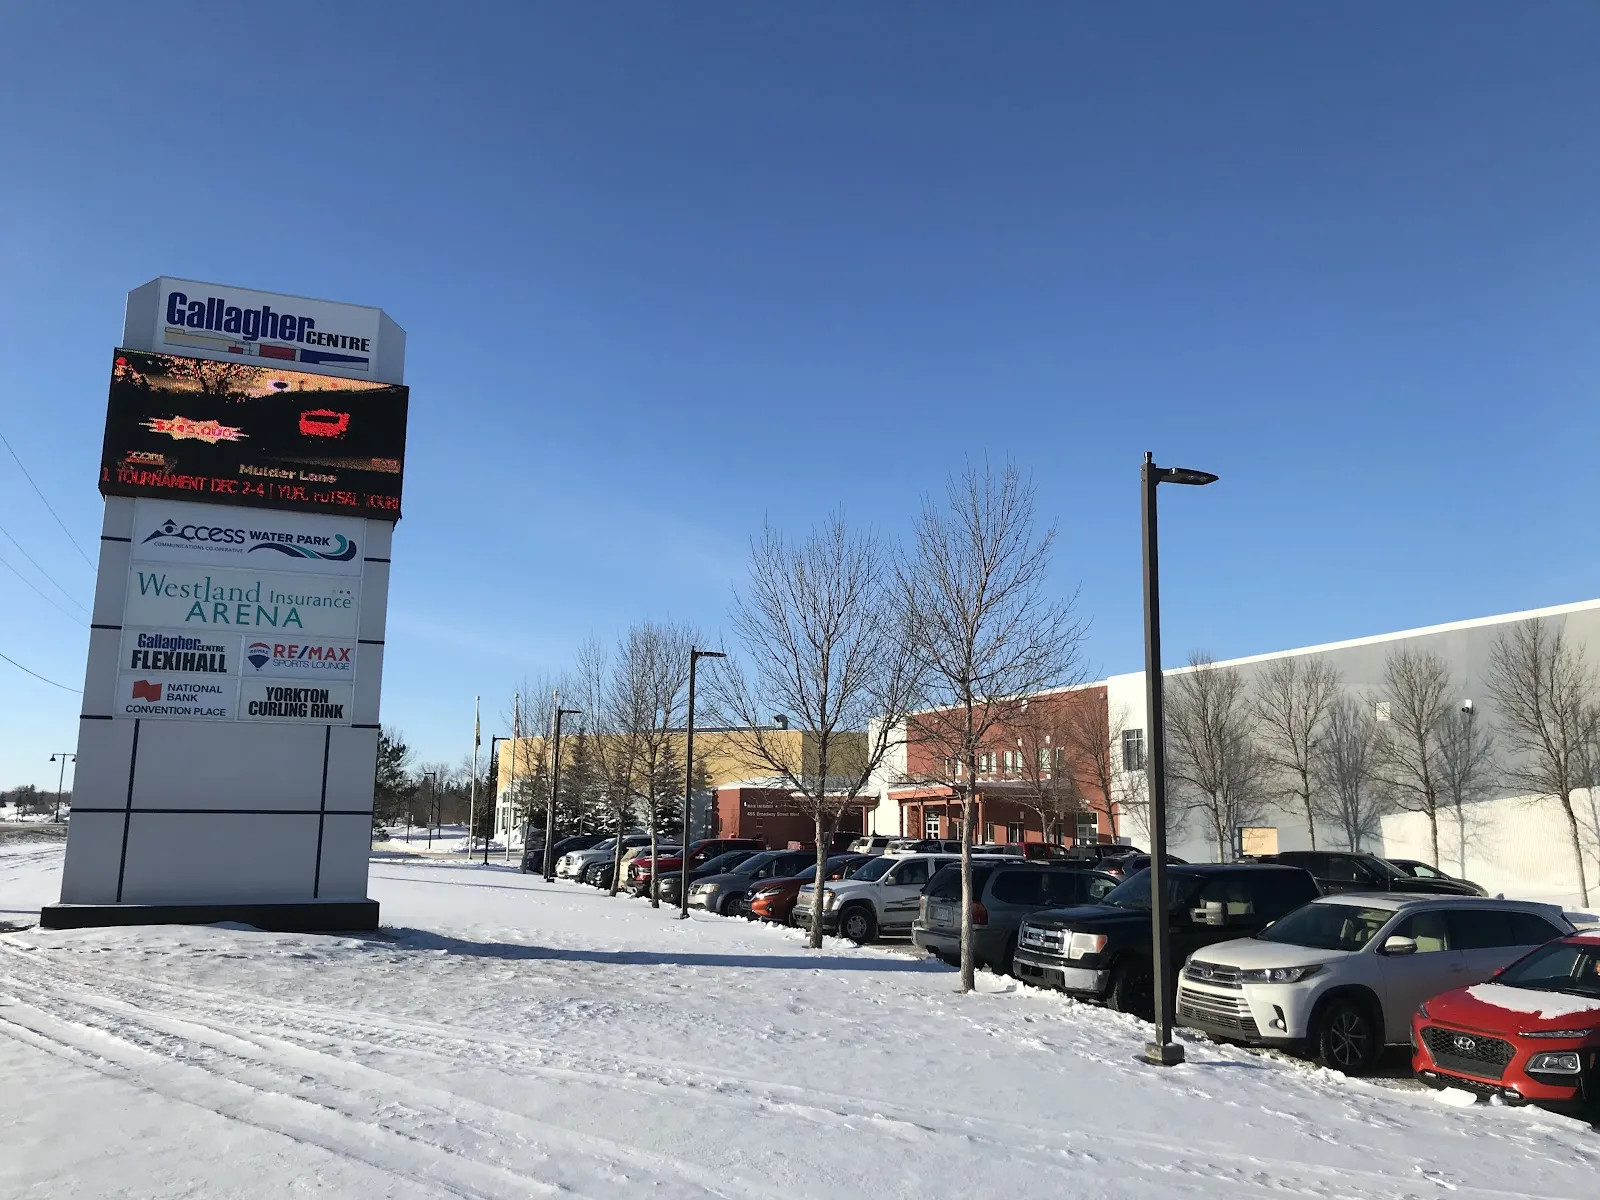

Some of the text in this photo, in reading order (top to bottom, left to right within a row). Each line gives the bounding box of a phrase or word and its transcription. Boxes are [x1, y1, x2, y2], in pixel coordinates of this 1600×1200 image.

[166, 291, 371, 352] Gallagher CENTRE
[116, 467, 208, 492] TOURNAMENT
[211, 478, 239, 494] DEC
[249, 530, 331, 547] WATER PARK
[137, 571, 352, 609] Westland Insurance
[184, 600, 304, 628] ARENA
[137, 632, 226, 653] Gallagher CENTRE
[130, 649, 228, 674] FLEXIHALL
[273, 643, 352, 662] RE/MAX
[272, 658, 351, 671] SPORTS LOUNGE
[166, 692, 198, 703] BANK
[167, 683, 223, 694] NATIONAL
[265, 686, 330, 704] YORKTON
[125, 704, 227, 717] CONVENTION PLACE
[248, 700, 344, 719] CURLING RINK
